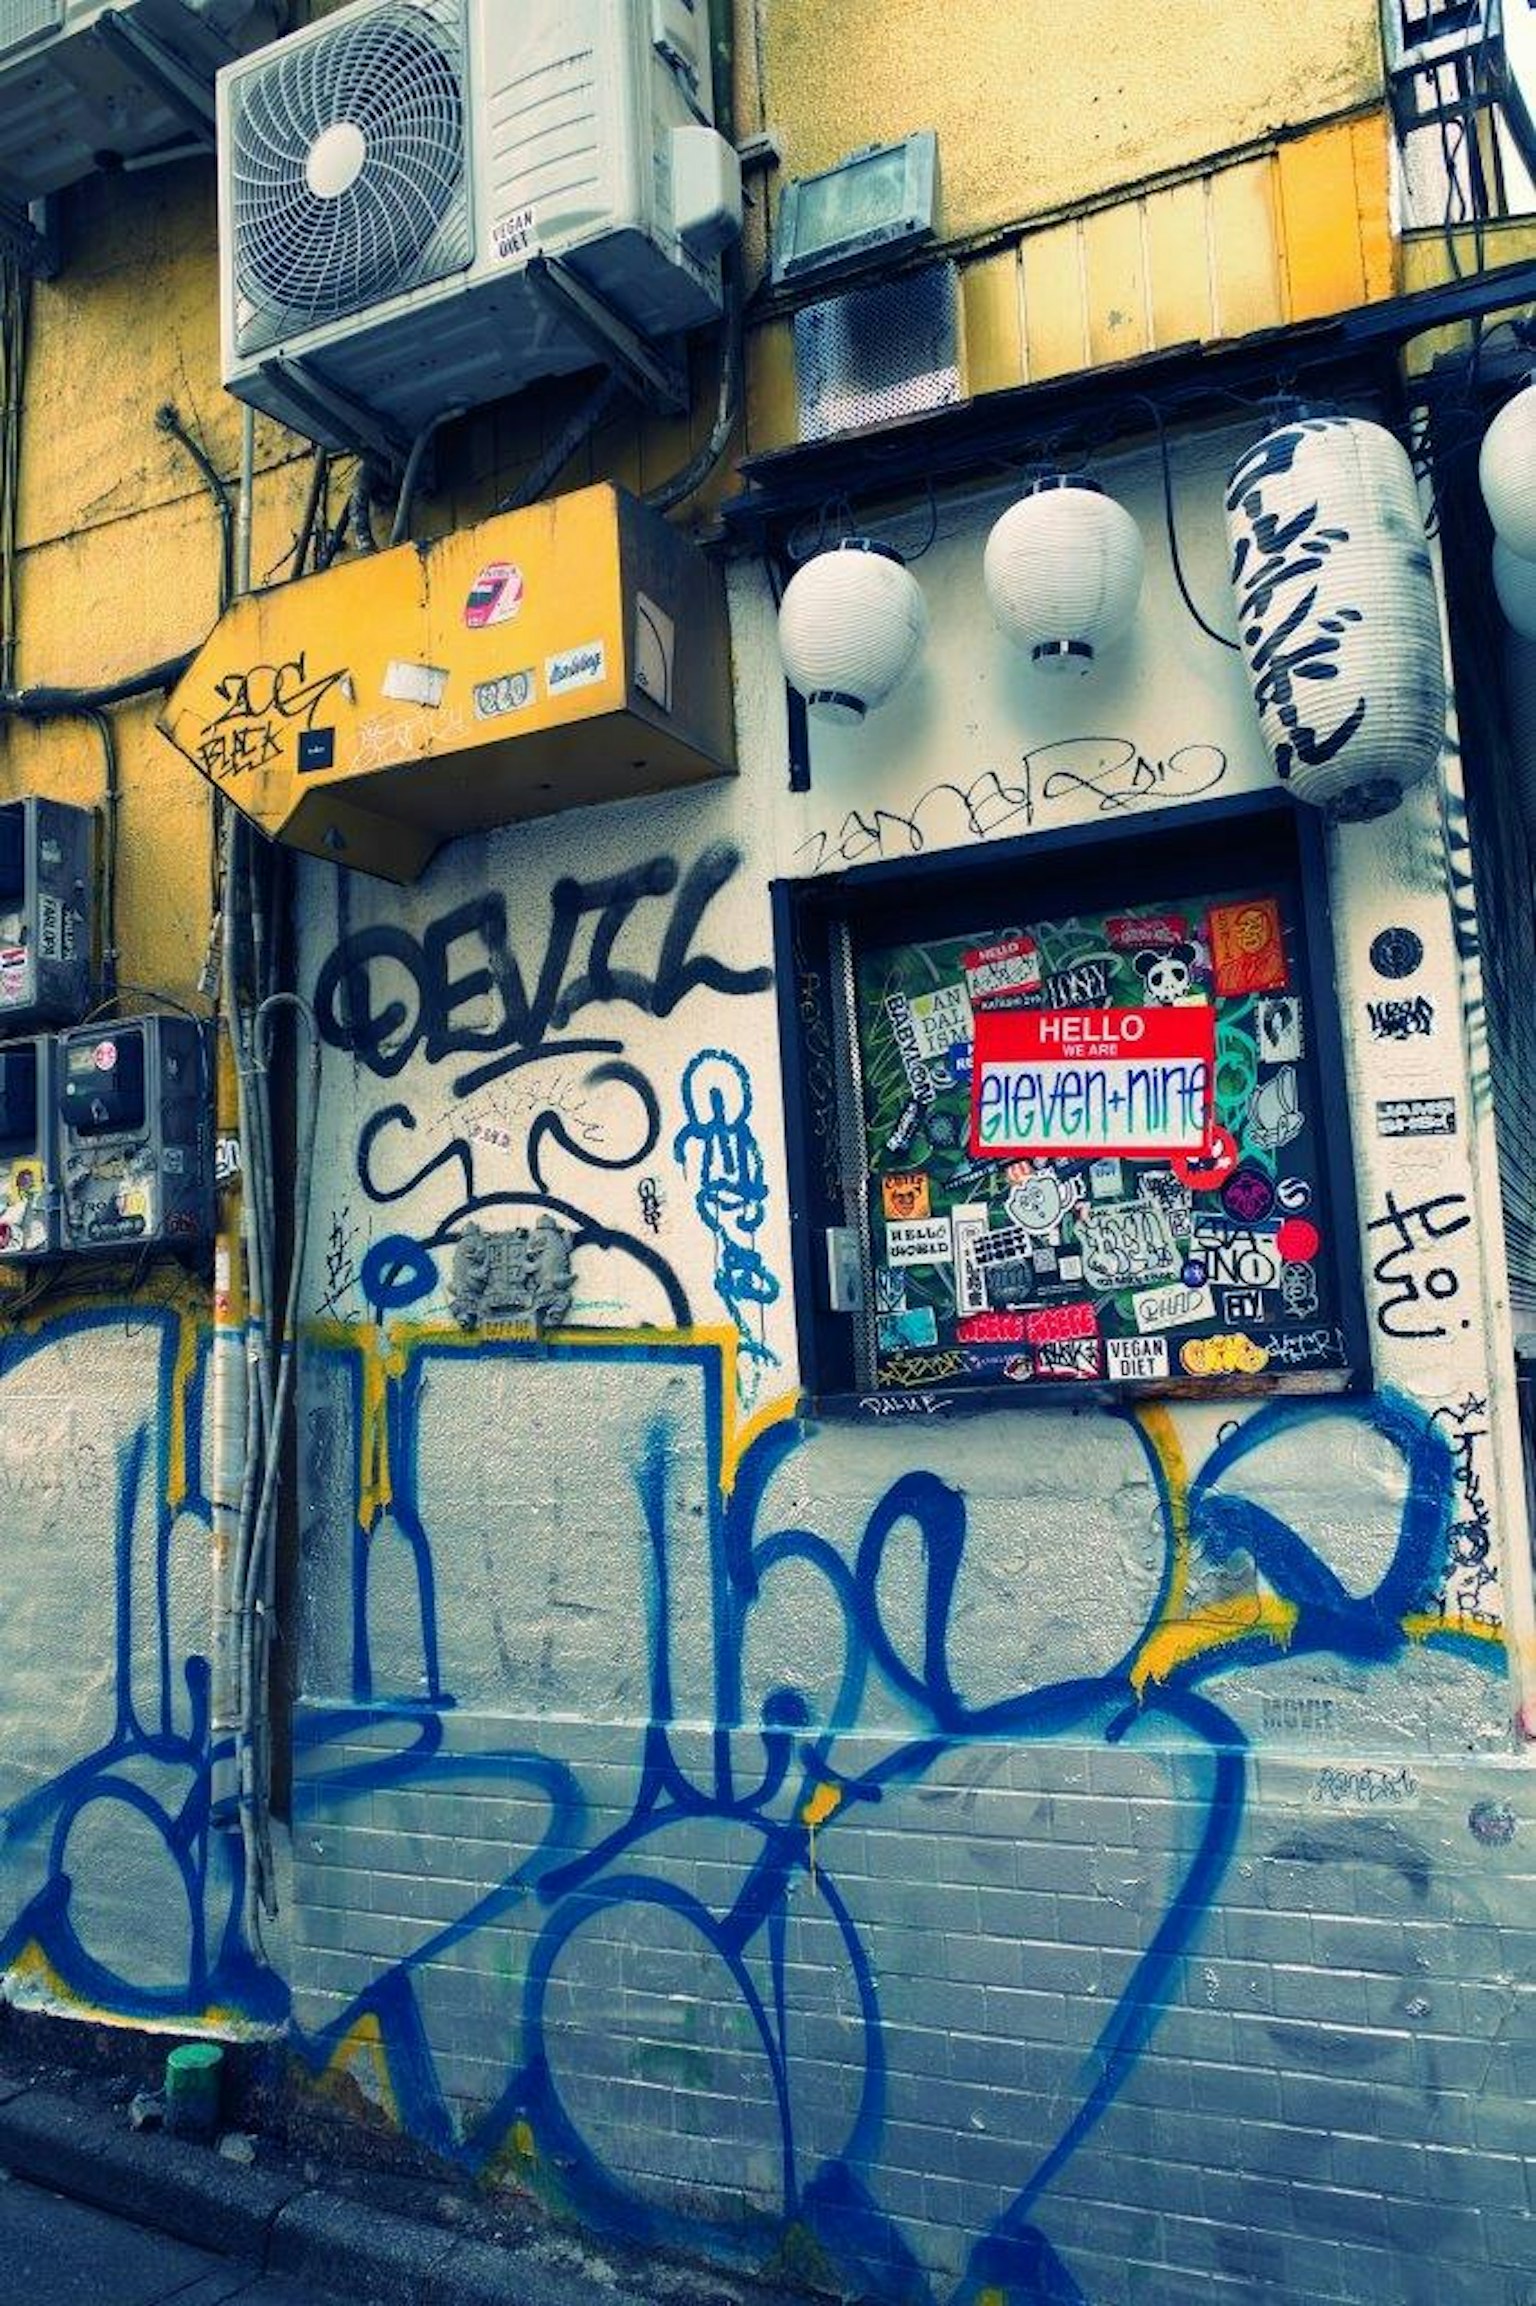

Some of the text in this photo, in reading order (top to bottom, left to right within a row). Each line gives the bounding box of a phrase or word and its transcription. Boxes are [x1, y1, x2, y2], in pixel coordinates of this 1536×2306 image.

[1039, 1014, 1146, 1043] HELLO
[1062, 1043, 1118, 1057] WE ARE
[891, 1225, 947, 1242] HELLO
[1111, 1337, 1163, 1357] VEGAN
[1121, 1357, 1155, 1376] DIET
